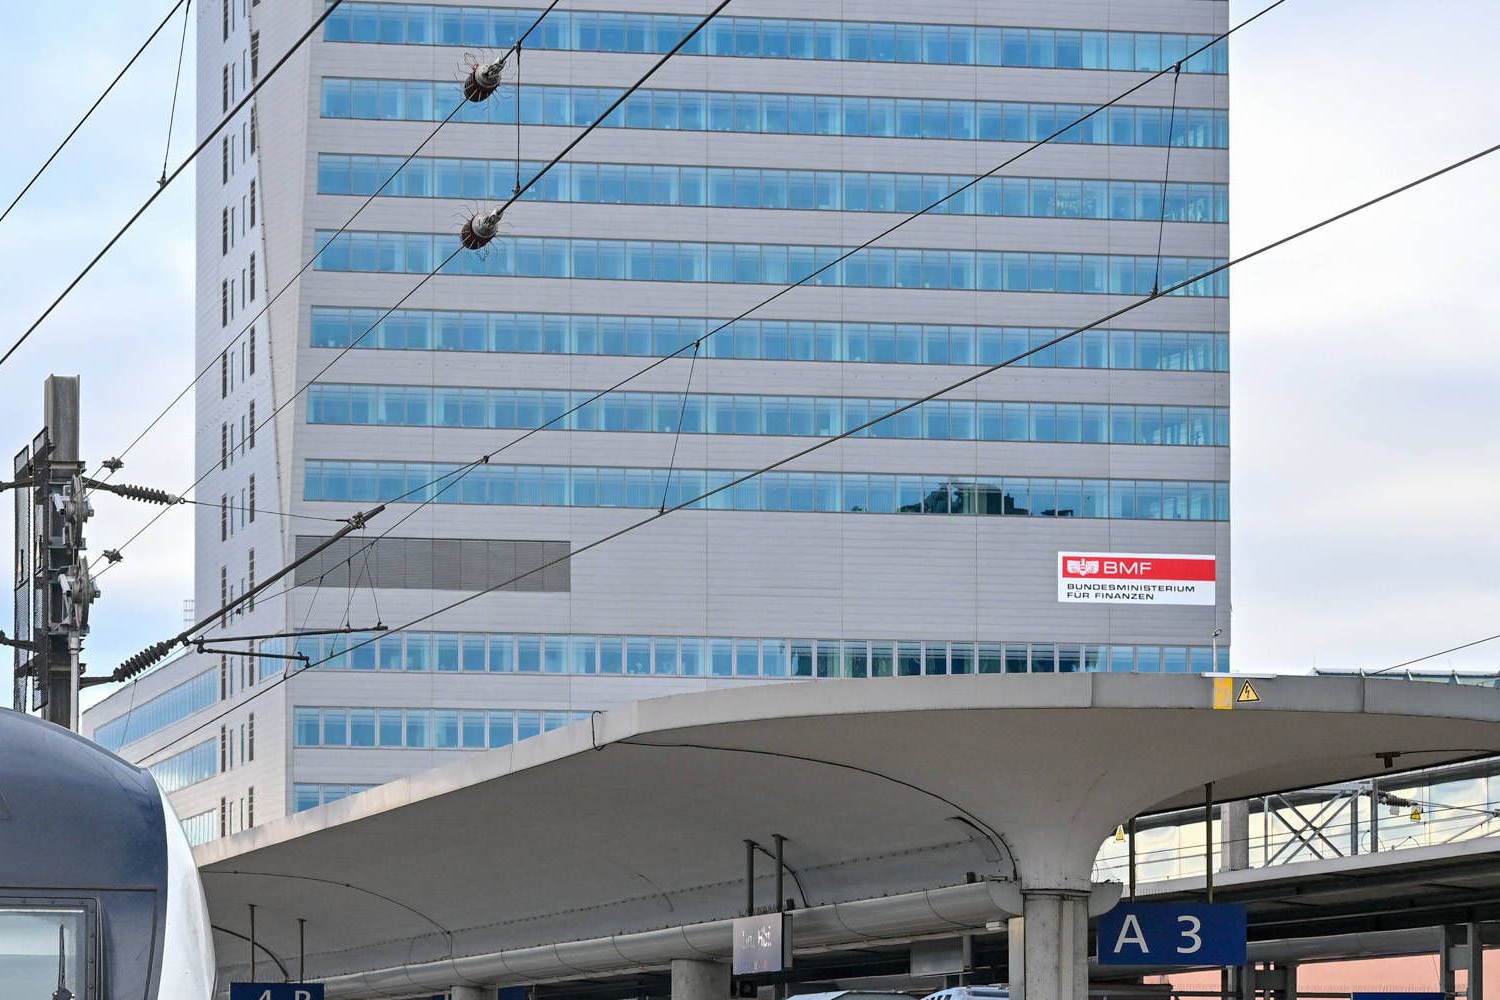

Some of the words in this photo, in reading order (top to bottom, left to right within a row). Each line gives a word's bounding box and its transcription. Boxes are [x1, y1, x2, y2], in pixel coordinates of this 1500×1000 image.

[1103, 561, 1152, 575] BMF
[1067, 583, 1196, 593] BUNDESMINISTERIUM
[1067, 591, 1090, 599] FÜR
[1113, 914, 1150, 954] A
[1176, 915, 1202, 955] 3
